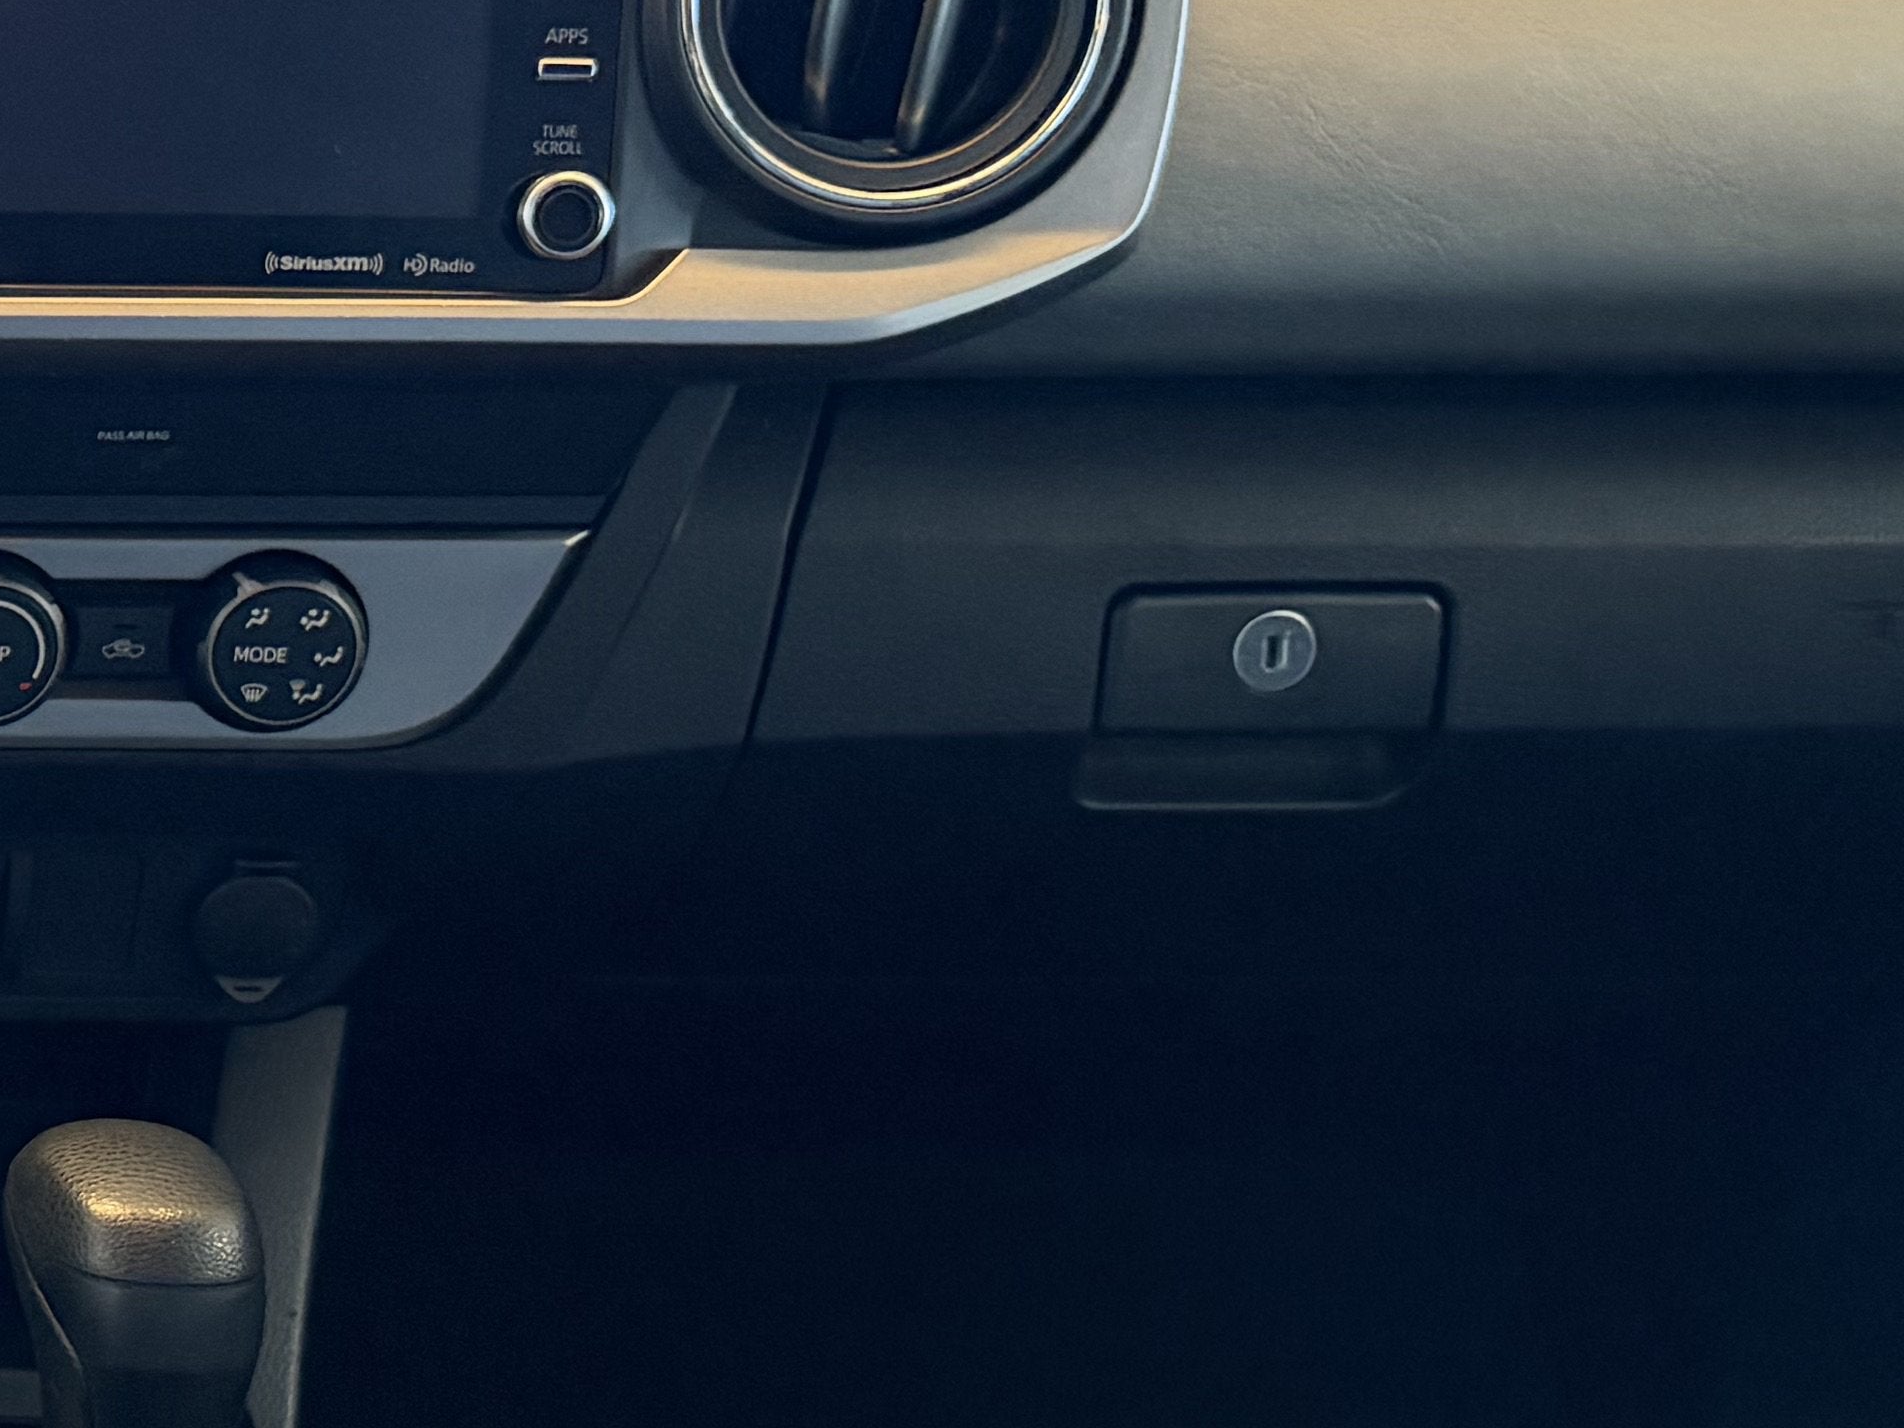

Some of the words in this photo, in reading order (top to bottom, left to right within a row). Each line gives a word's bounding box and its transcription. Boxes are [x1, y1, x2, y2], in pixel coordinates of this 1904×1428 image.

[545, 28, 589, 46] APPS
[542, 124, 578, 140] TUNE
[533, 140, 583, 156] SCROLL
[429, 256, 475, 274] Radio
[233, 646, 289, 664] MODE
